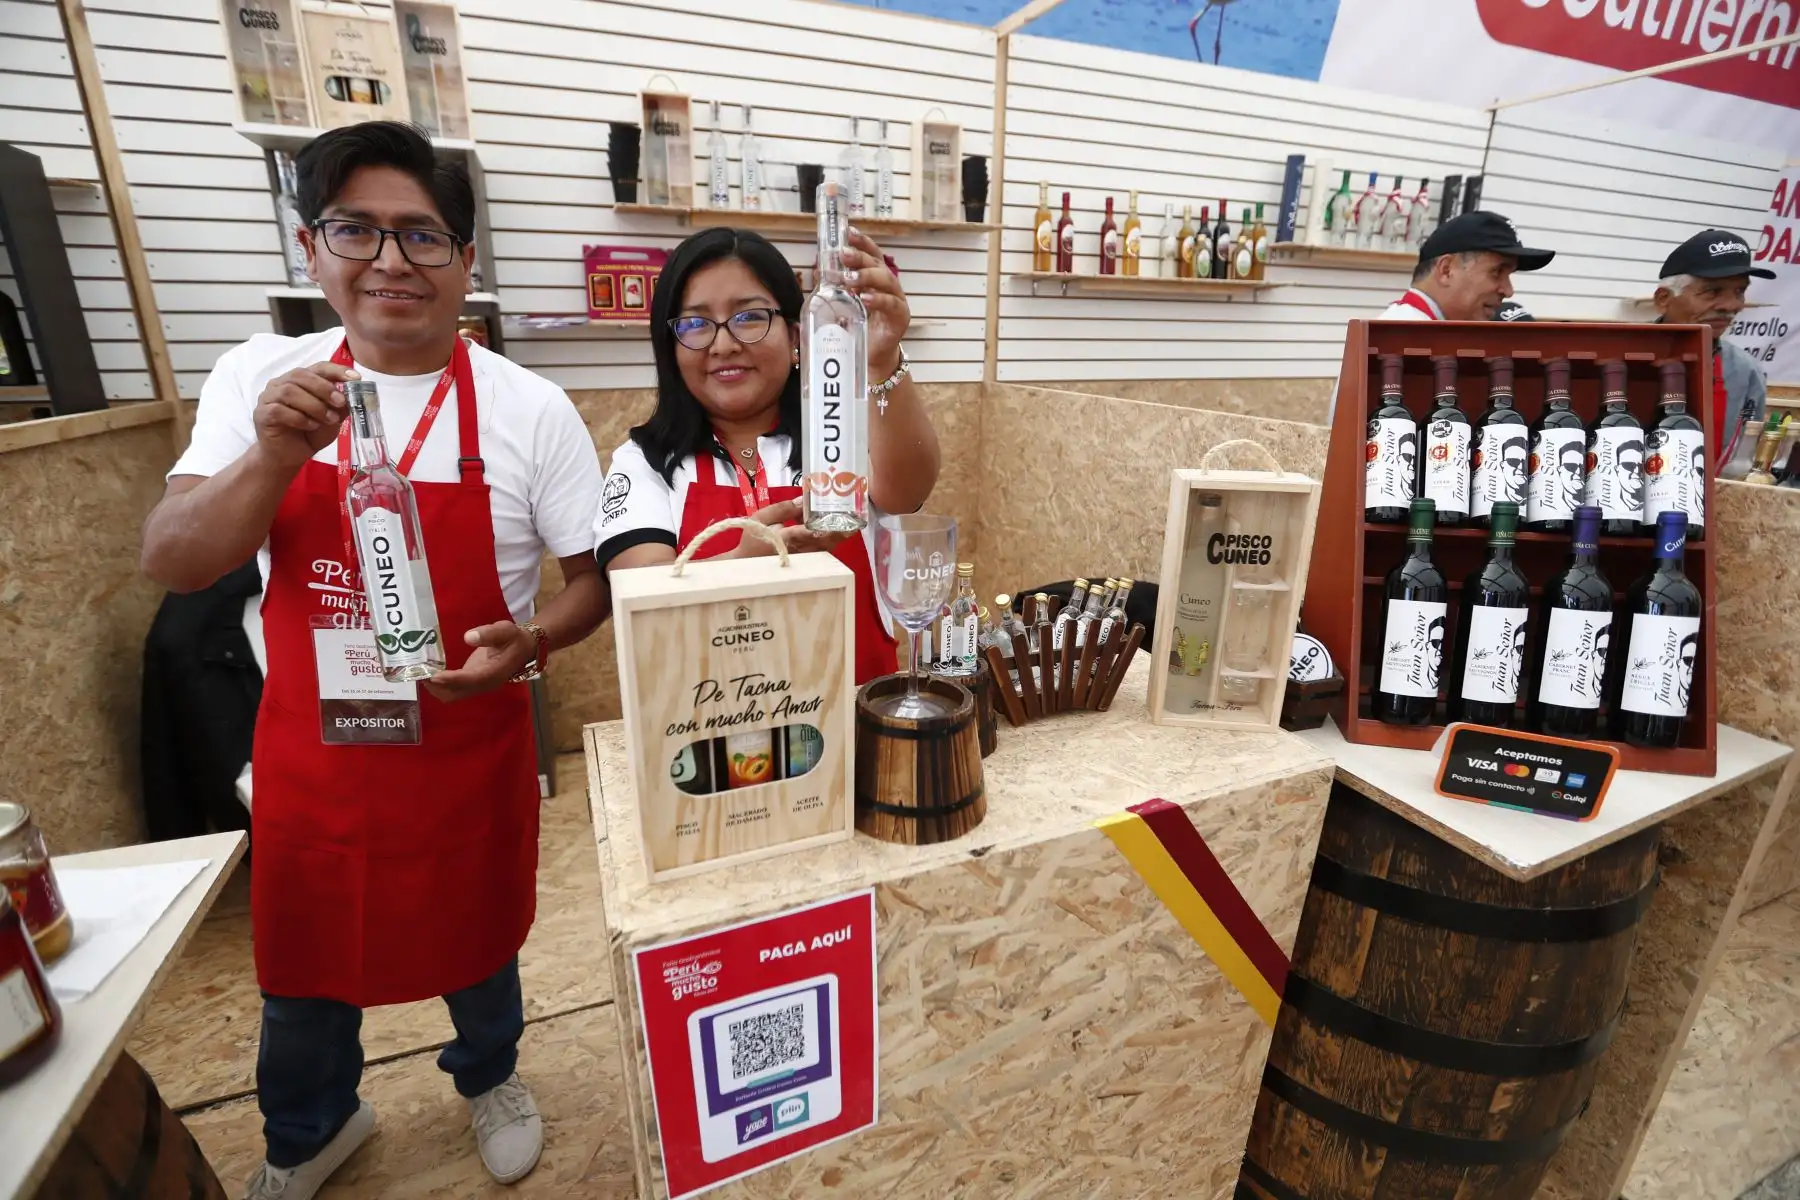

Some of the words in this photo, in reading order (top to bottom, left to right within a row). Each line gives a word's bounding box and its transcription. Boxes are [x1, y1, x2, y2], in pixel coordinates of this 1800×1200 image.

[823, 357, 841, 463] CUNEO
[1382, 428, 1396, 465] Señor
[1454, 432, 1465, 468] Señor
[1485, 434, 1498, 471] Señor
[1542, 438, 1555, 475] Señor
[1599, 437, 1612, 475] Señor
[1673, 440, 1688, 476] Señor
[1381, 467, 1395, 497] Juan
[1452, 472, 1465, 502] Juan
[1484, 473, 1497, 503] Juan
[1540, 478, 1557, 510] Juan
[1597, 478, 1615, 510] Juan
[1672, 481, 1690, 513] Juan
[1207, 532, 1271, 566] CUNEO
[1226, 535, 1272, 549] PISCO
[372, 536, 403, 626] CUNEO
[904, 562, 956, 580] CUNEO
[321, 593, 368, 612] much
[712, 630, 774, 647] CUNEO
[1410, 611, 1428, 650] Señor
[1496, 618, 1514, 657] Señor
[1575, 619, 1594, 660] Señor
[345, 649, 371, 658] Perú
[1290, 647, 1319, 679] UNEO
[1658, 627, 1678, 669] Señor
[1406, 653, 1423, 688] Juan
[1492, 660, 1508, 694] Juan
[1570, 662, 1588, 697] Juan
[693, 680, 724, 708] De
[729, 673, 792, 702] Tacna
[1654, 671, 1673, 707] Juan
[335, 717, 406, 728] EXPOSITOR
[666, 720, 700, 736] con
[704, 700, 767, 728] mucho
[770, 695, 824, 719] Amor
[1466, 757, 1498, 772] VISA
[1495, 747, 1563, 766] Aceptamos
[1488, 780, 1525, 792] contacto
[1563, 793, 1587, 804] Culqi
[759, 940, 806, 963] PAGA
[810, 924, 853, 950] AQUÍ
[663, 960, 700, 978] Perú
[672, 975, 701, 987] mucho
[672, 976, 718, 1000] gusto
[742, 1116, 768, 1141] yape
